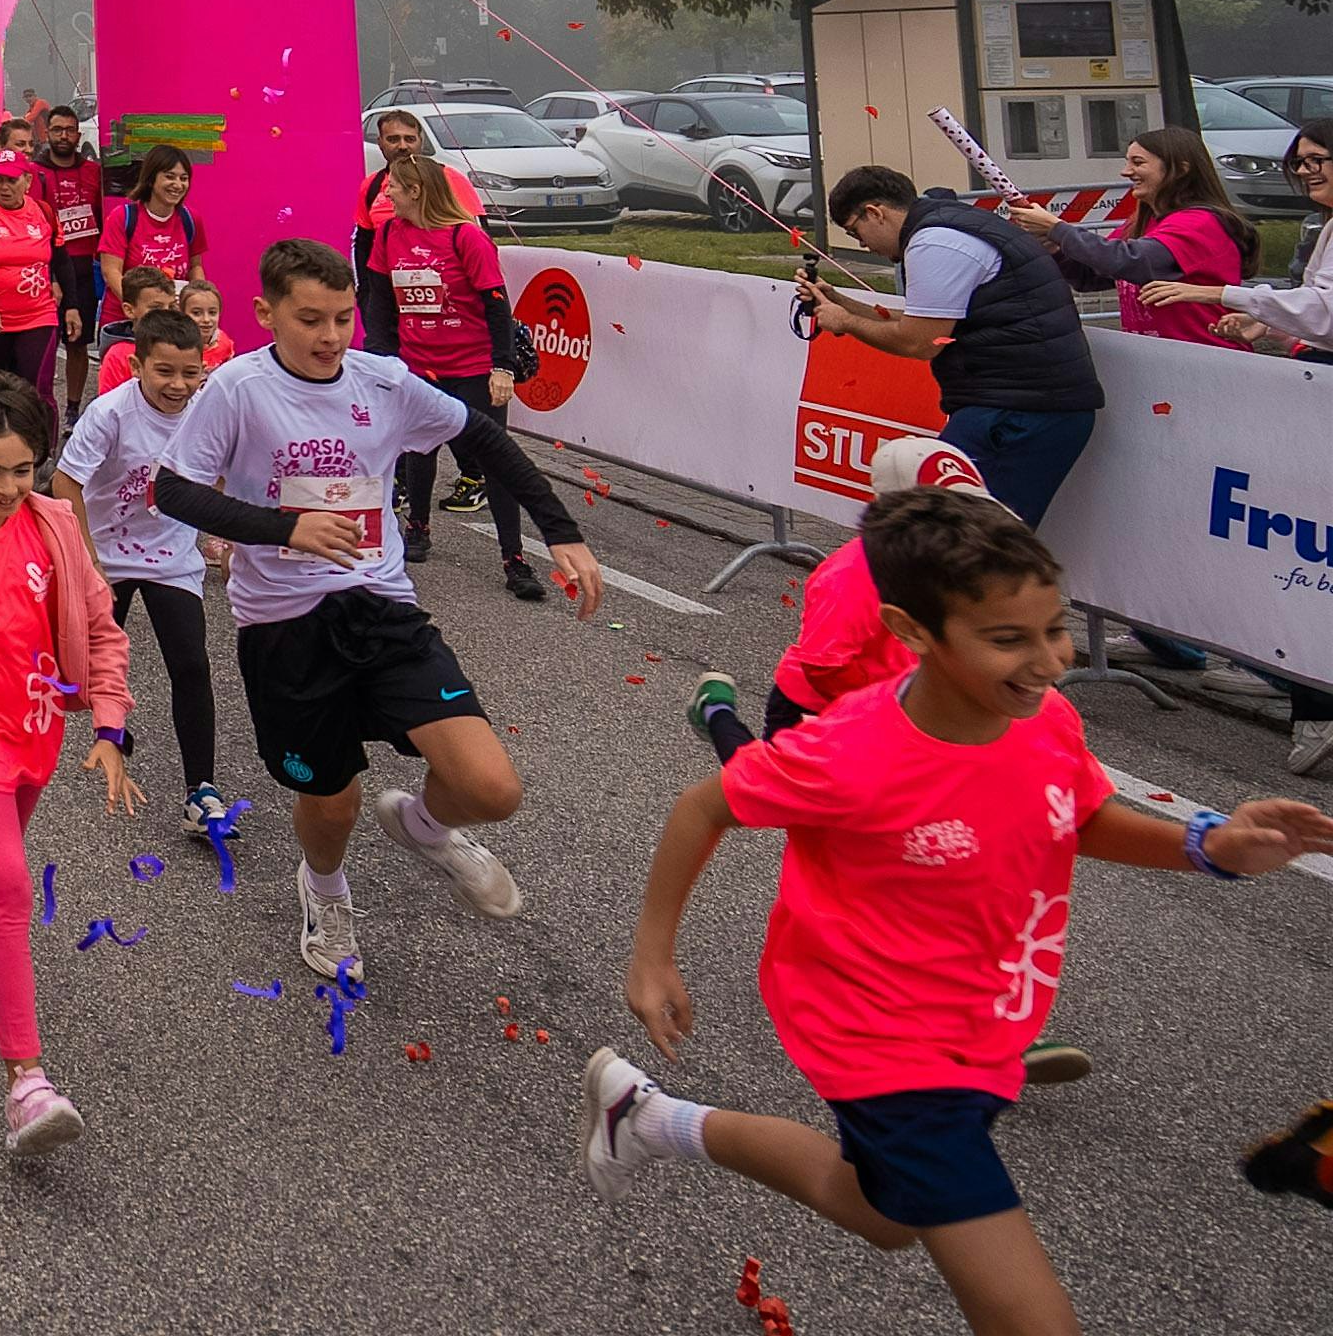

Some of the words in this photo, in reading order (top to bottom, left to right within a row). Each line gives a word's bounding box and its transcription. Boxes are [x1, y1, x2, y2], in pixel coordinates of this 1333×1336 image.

[63, 218, 89, 233] 407
[403, 287, 436, 303] 399
[288, 439, 346, 459] CORSA
